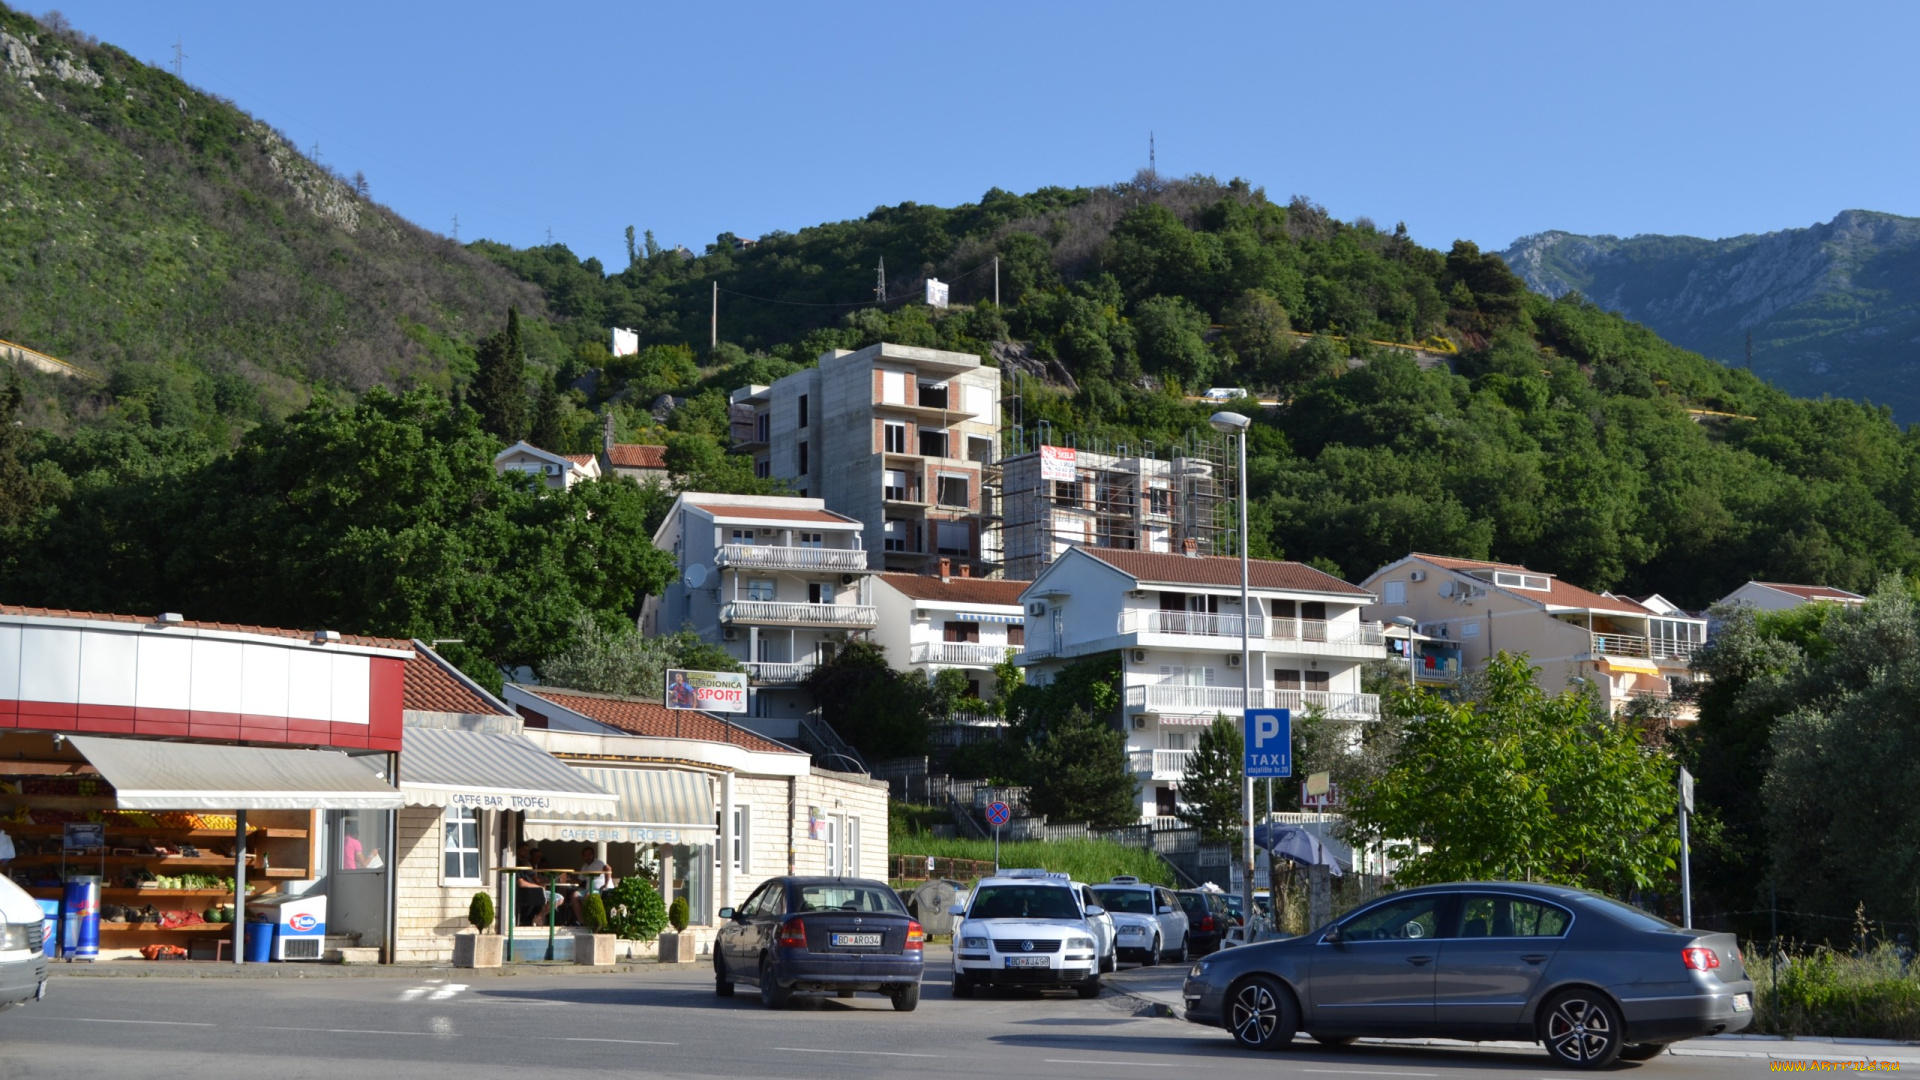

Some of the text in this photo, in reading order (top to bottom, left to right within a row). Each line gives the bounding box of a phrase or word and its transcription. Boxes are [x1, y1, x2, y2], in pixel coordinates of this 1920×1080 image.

[689, 679, 742, 689] KLADIONICA
[698, 688, 742, 701] SPORT
[1255, 715, 1279, 748] P
[1251, 754, 1285, 766] TAXI
[452, 794, 550, 808] CAFFE BAR TROFEJ
[599, 829, 619, 840] BAR
[628, 828, 680, 842] TROFEJ
[838, 935, 879, 944] BD AR034
